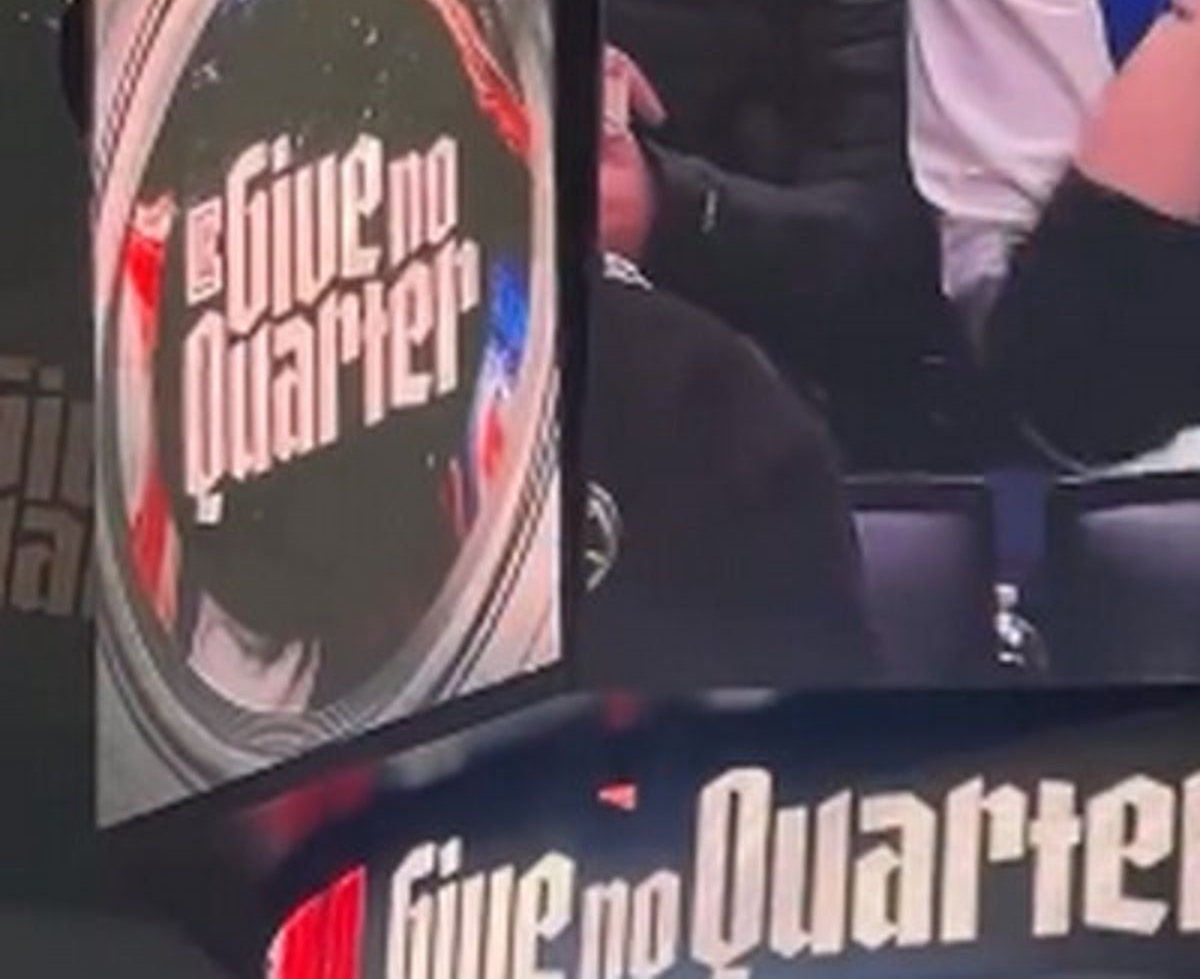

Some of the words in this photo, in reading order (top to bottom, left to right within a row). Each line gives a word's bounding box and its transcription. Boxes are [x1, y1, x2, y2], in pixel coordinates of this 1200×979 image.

[226, 132, 384, 335] Give
[388, 134, 457, 275] no
[185, 237, 480, 524] Quarter
[386, 835, 576, 979] Give
[580, 867, 682, 979] no
